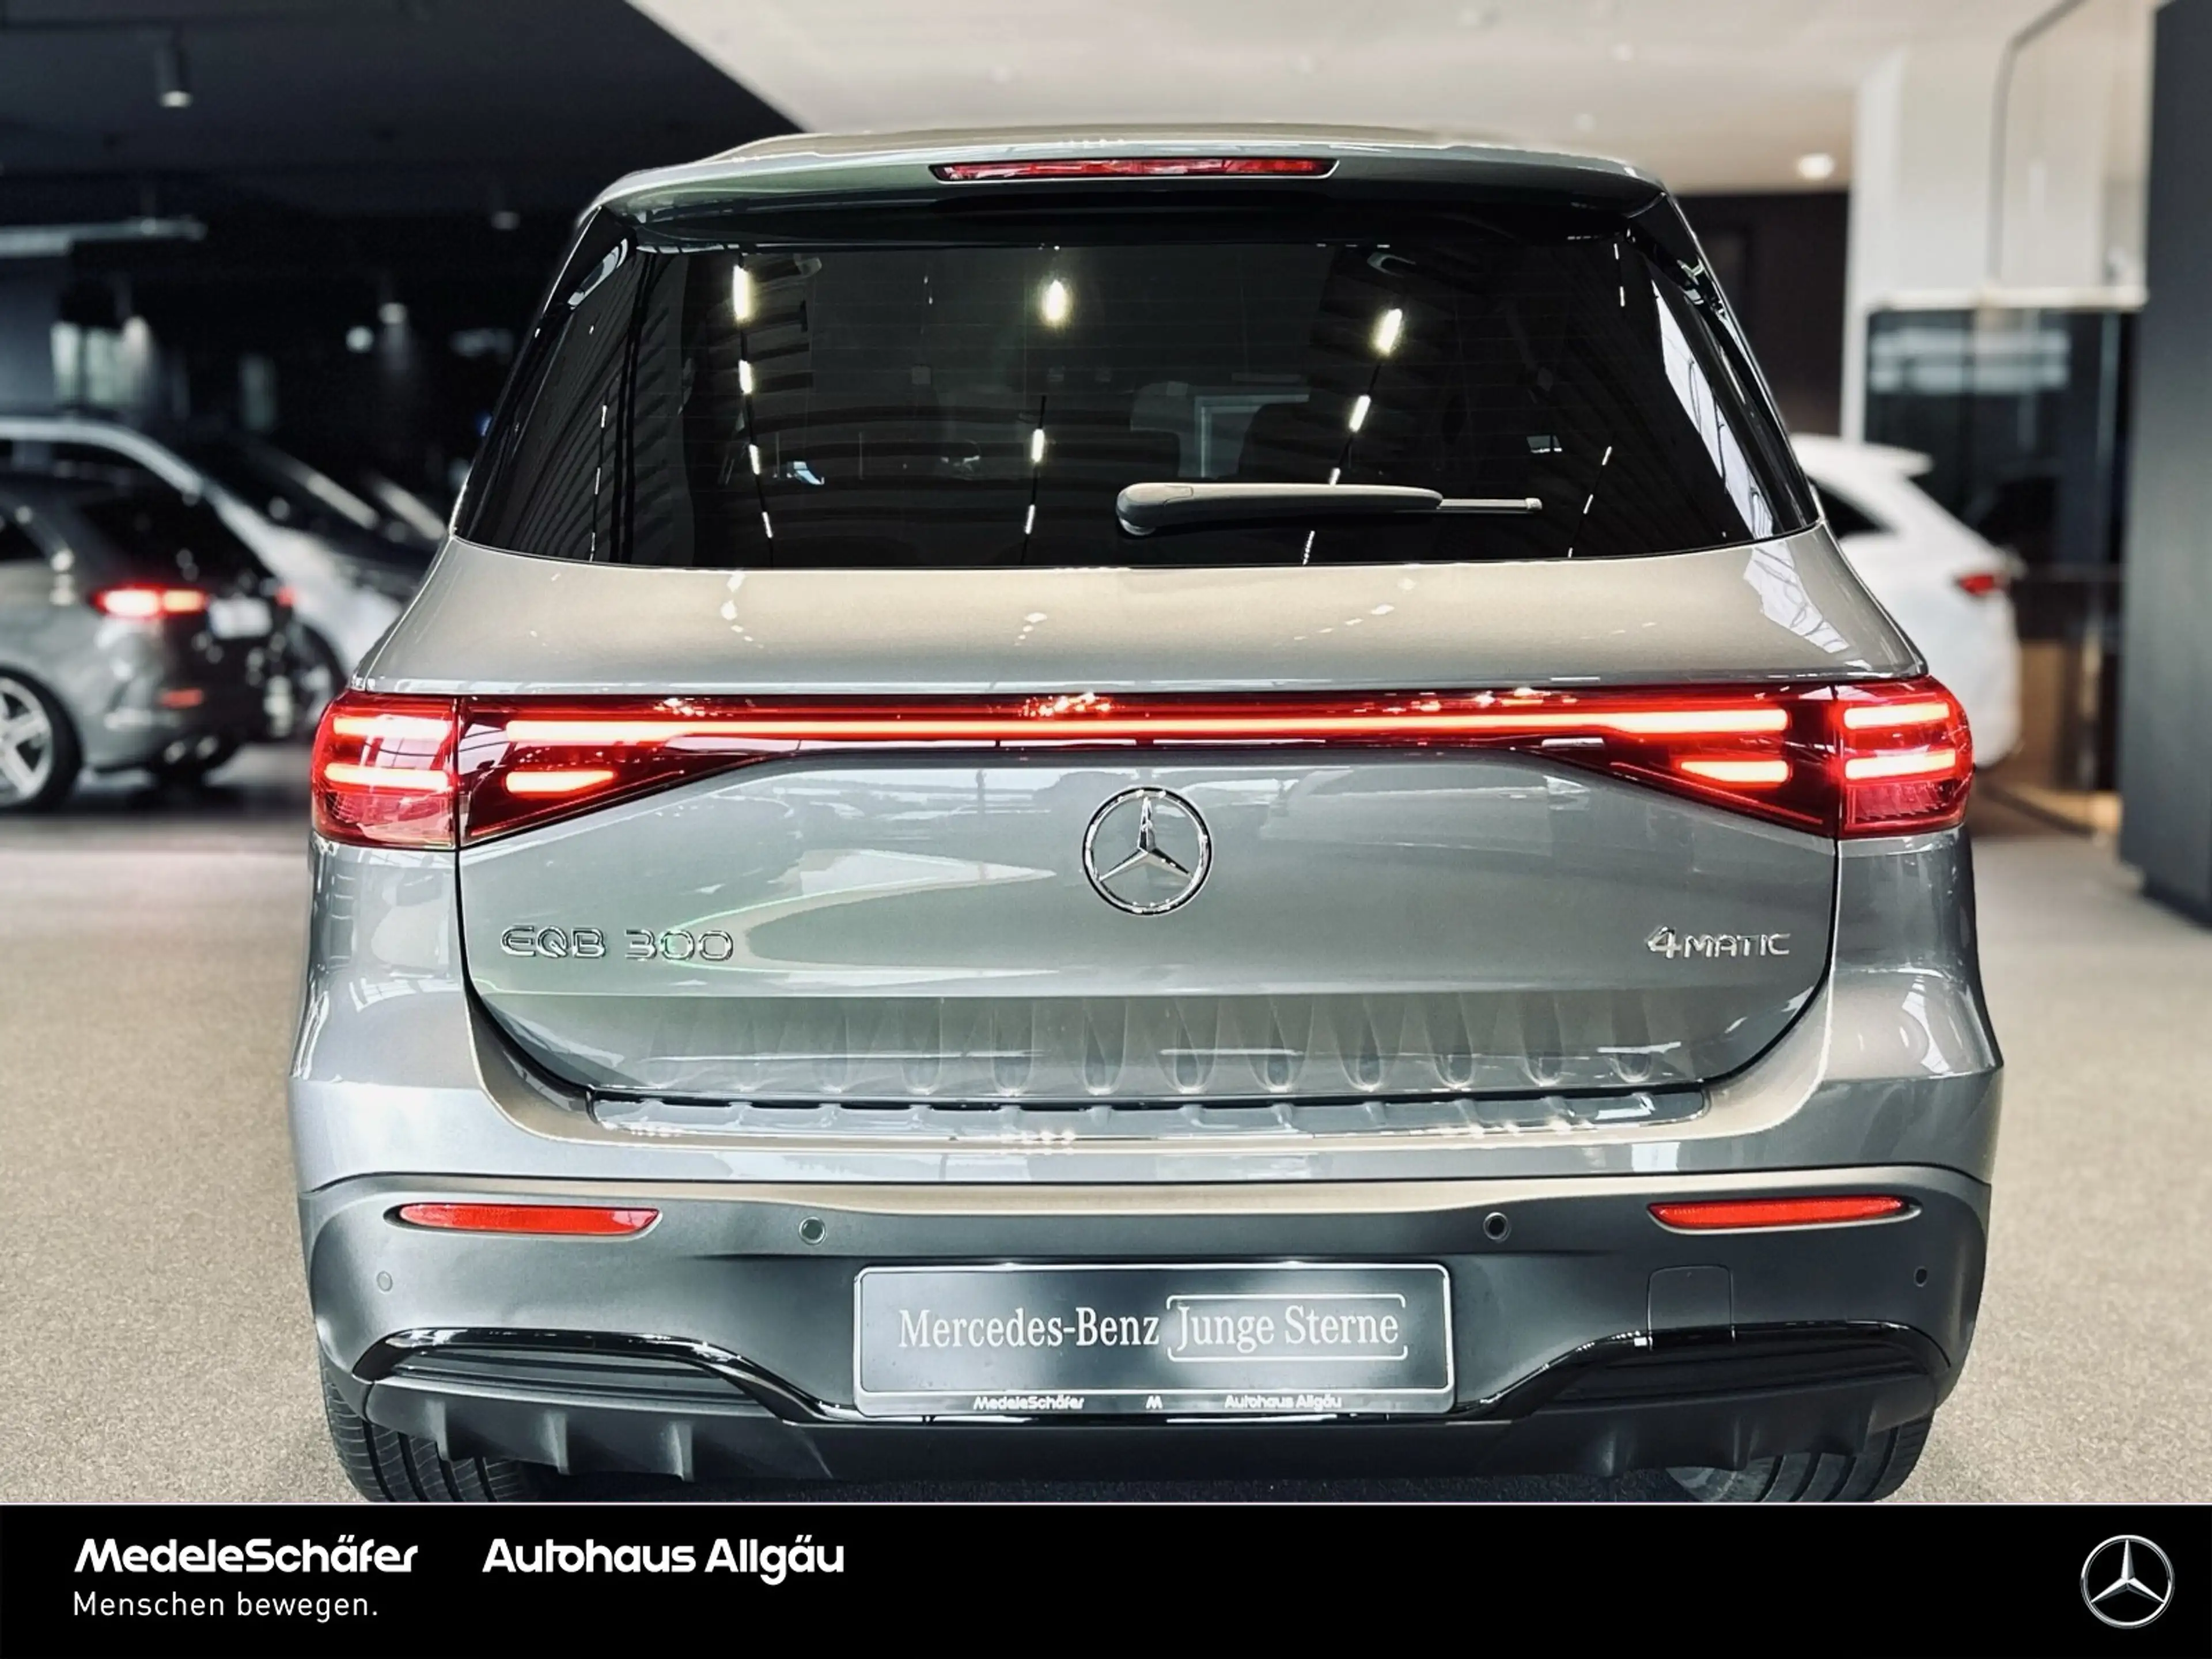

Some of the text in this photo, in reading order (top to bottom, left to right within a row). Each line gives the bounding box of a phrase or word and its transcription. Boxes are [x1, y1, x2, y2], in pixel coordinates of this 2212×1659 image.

[501, 925, 733, 961] EQB 300
[1646, 926, 1791, 959] 4MATIC
[899, 1303, 1399, 1354] Mercedes-Benz Junge Sterne
[973, 1394, 1085, 1411] MedeleSchäfer
[1224, 1393, 1342, 1412] Autohaus Allgäu
